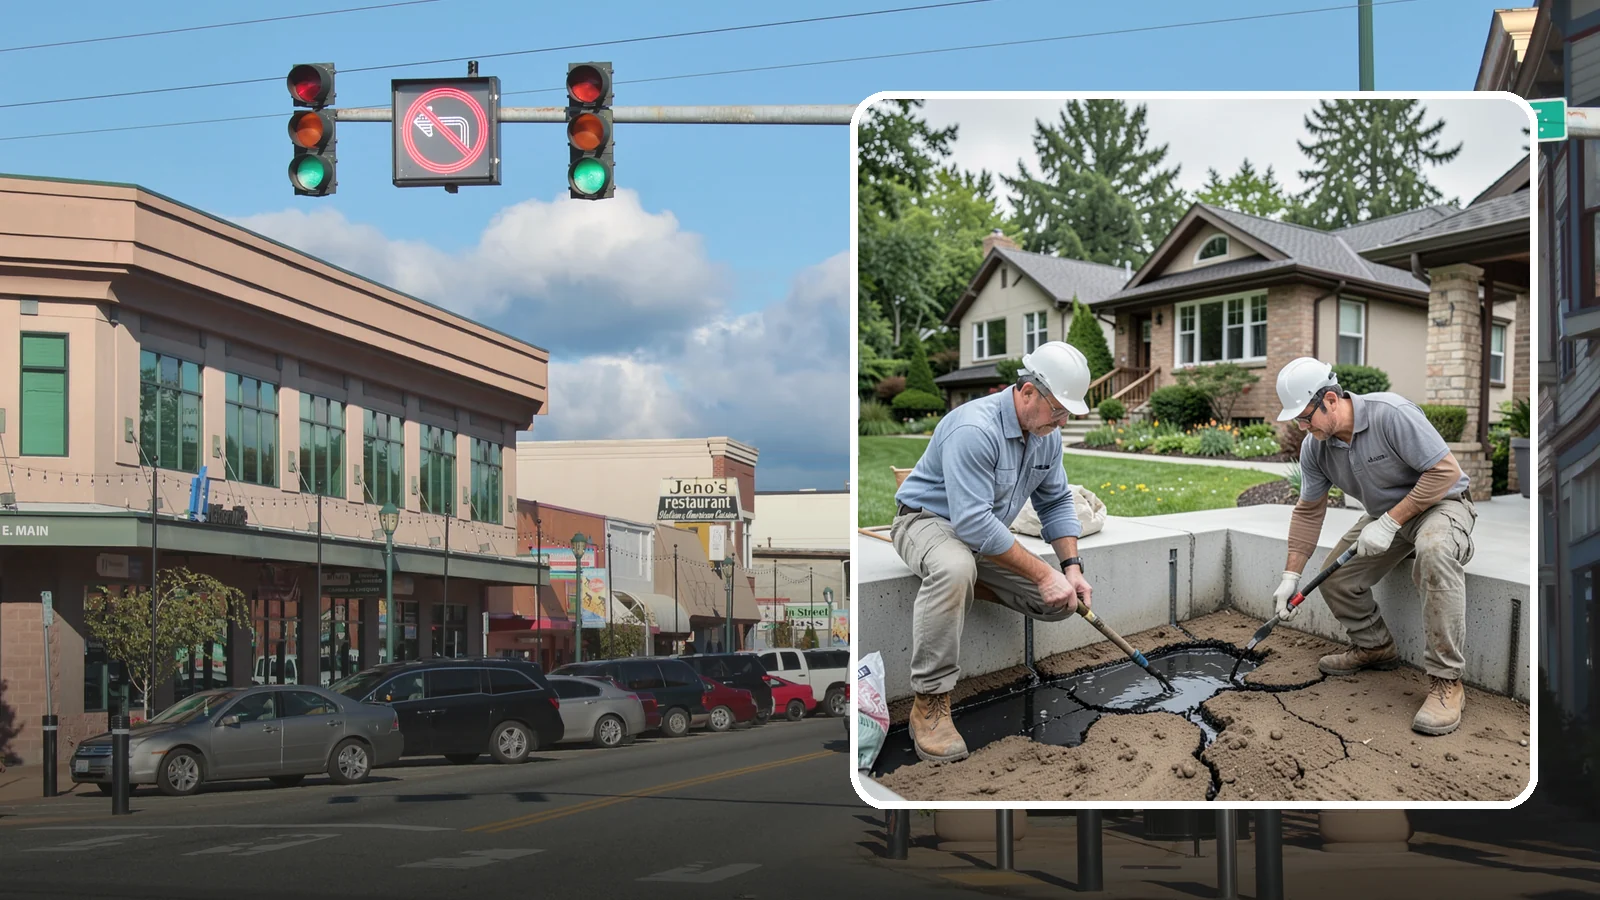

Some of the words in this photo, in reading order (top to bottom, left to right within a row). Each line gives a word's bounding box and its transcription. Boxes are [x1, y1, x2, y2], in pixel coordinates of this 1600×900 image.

[669, 480, 727, 494] Jeno's
[665, 496, 731, 509] restaurant
[686, 509, 715, 519] American
[714, 509, 737, 519] Cuisine
[2, 525, 13, 536] E.
[15, 525, 49, 536] MAIN
[797, 607, 829, 617] Street
